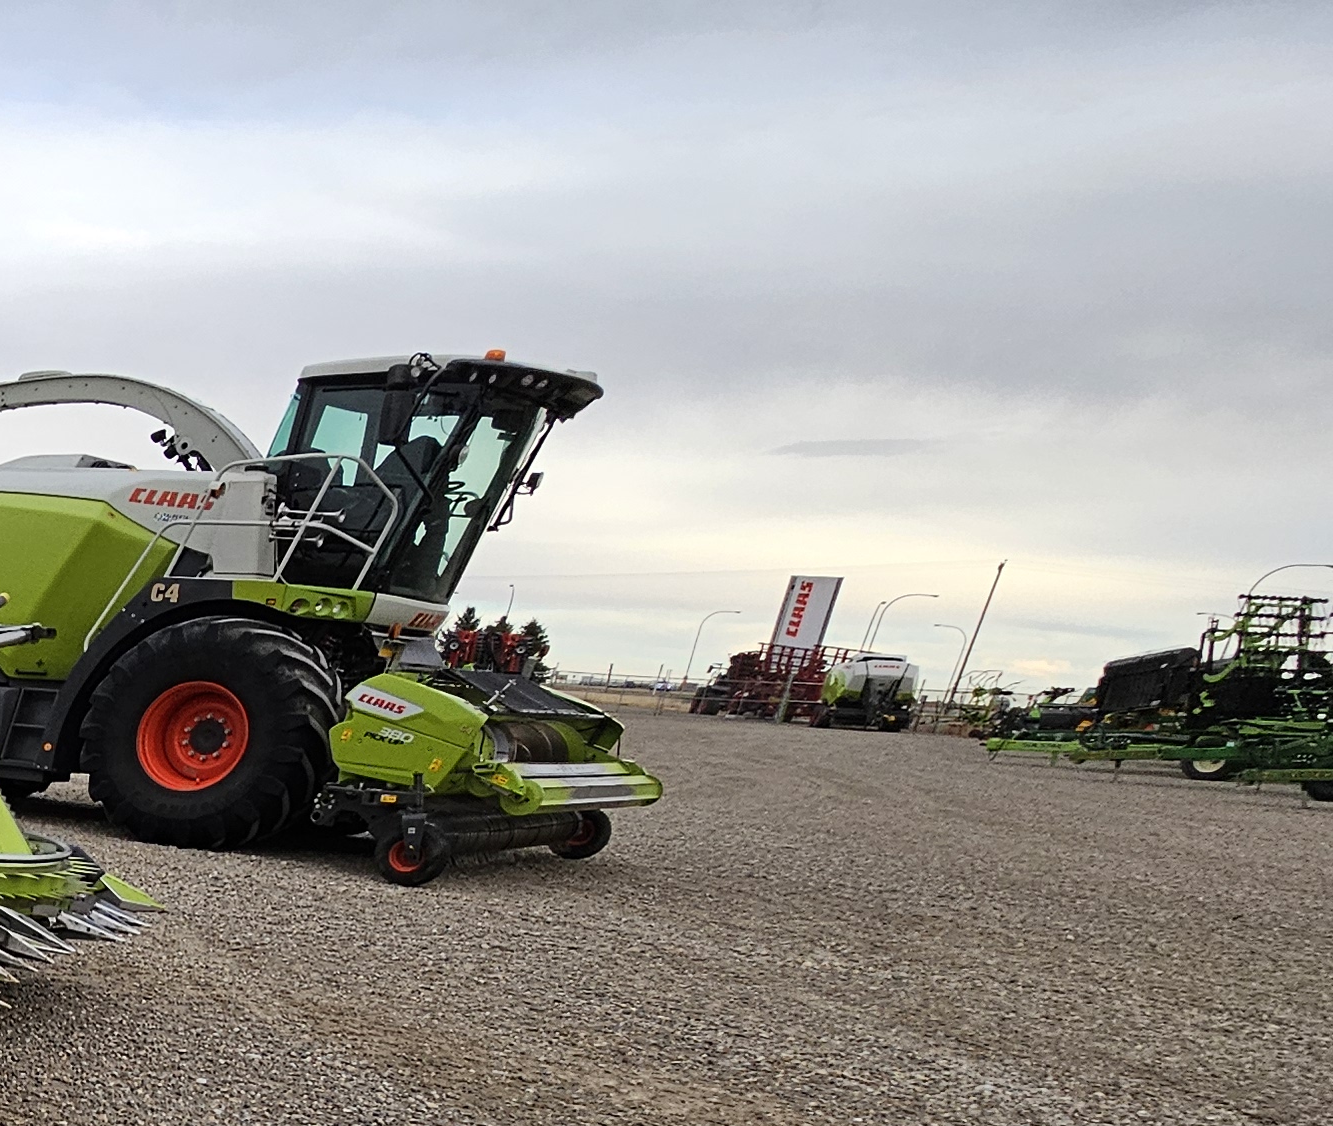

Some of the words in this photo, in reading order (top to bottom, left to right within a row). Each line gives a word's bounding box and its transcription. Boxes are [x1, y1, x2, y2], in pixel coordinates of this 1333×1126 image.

[151, 583, 180, 603] C4
[785, 581, 814, 637] CLAAS
[358, 693, 406, 715] CLAAS
[378, 726, 414, 743] 380
